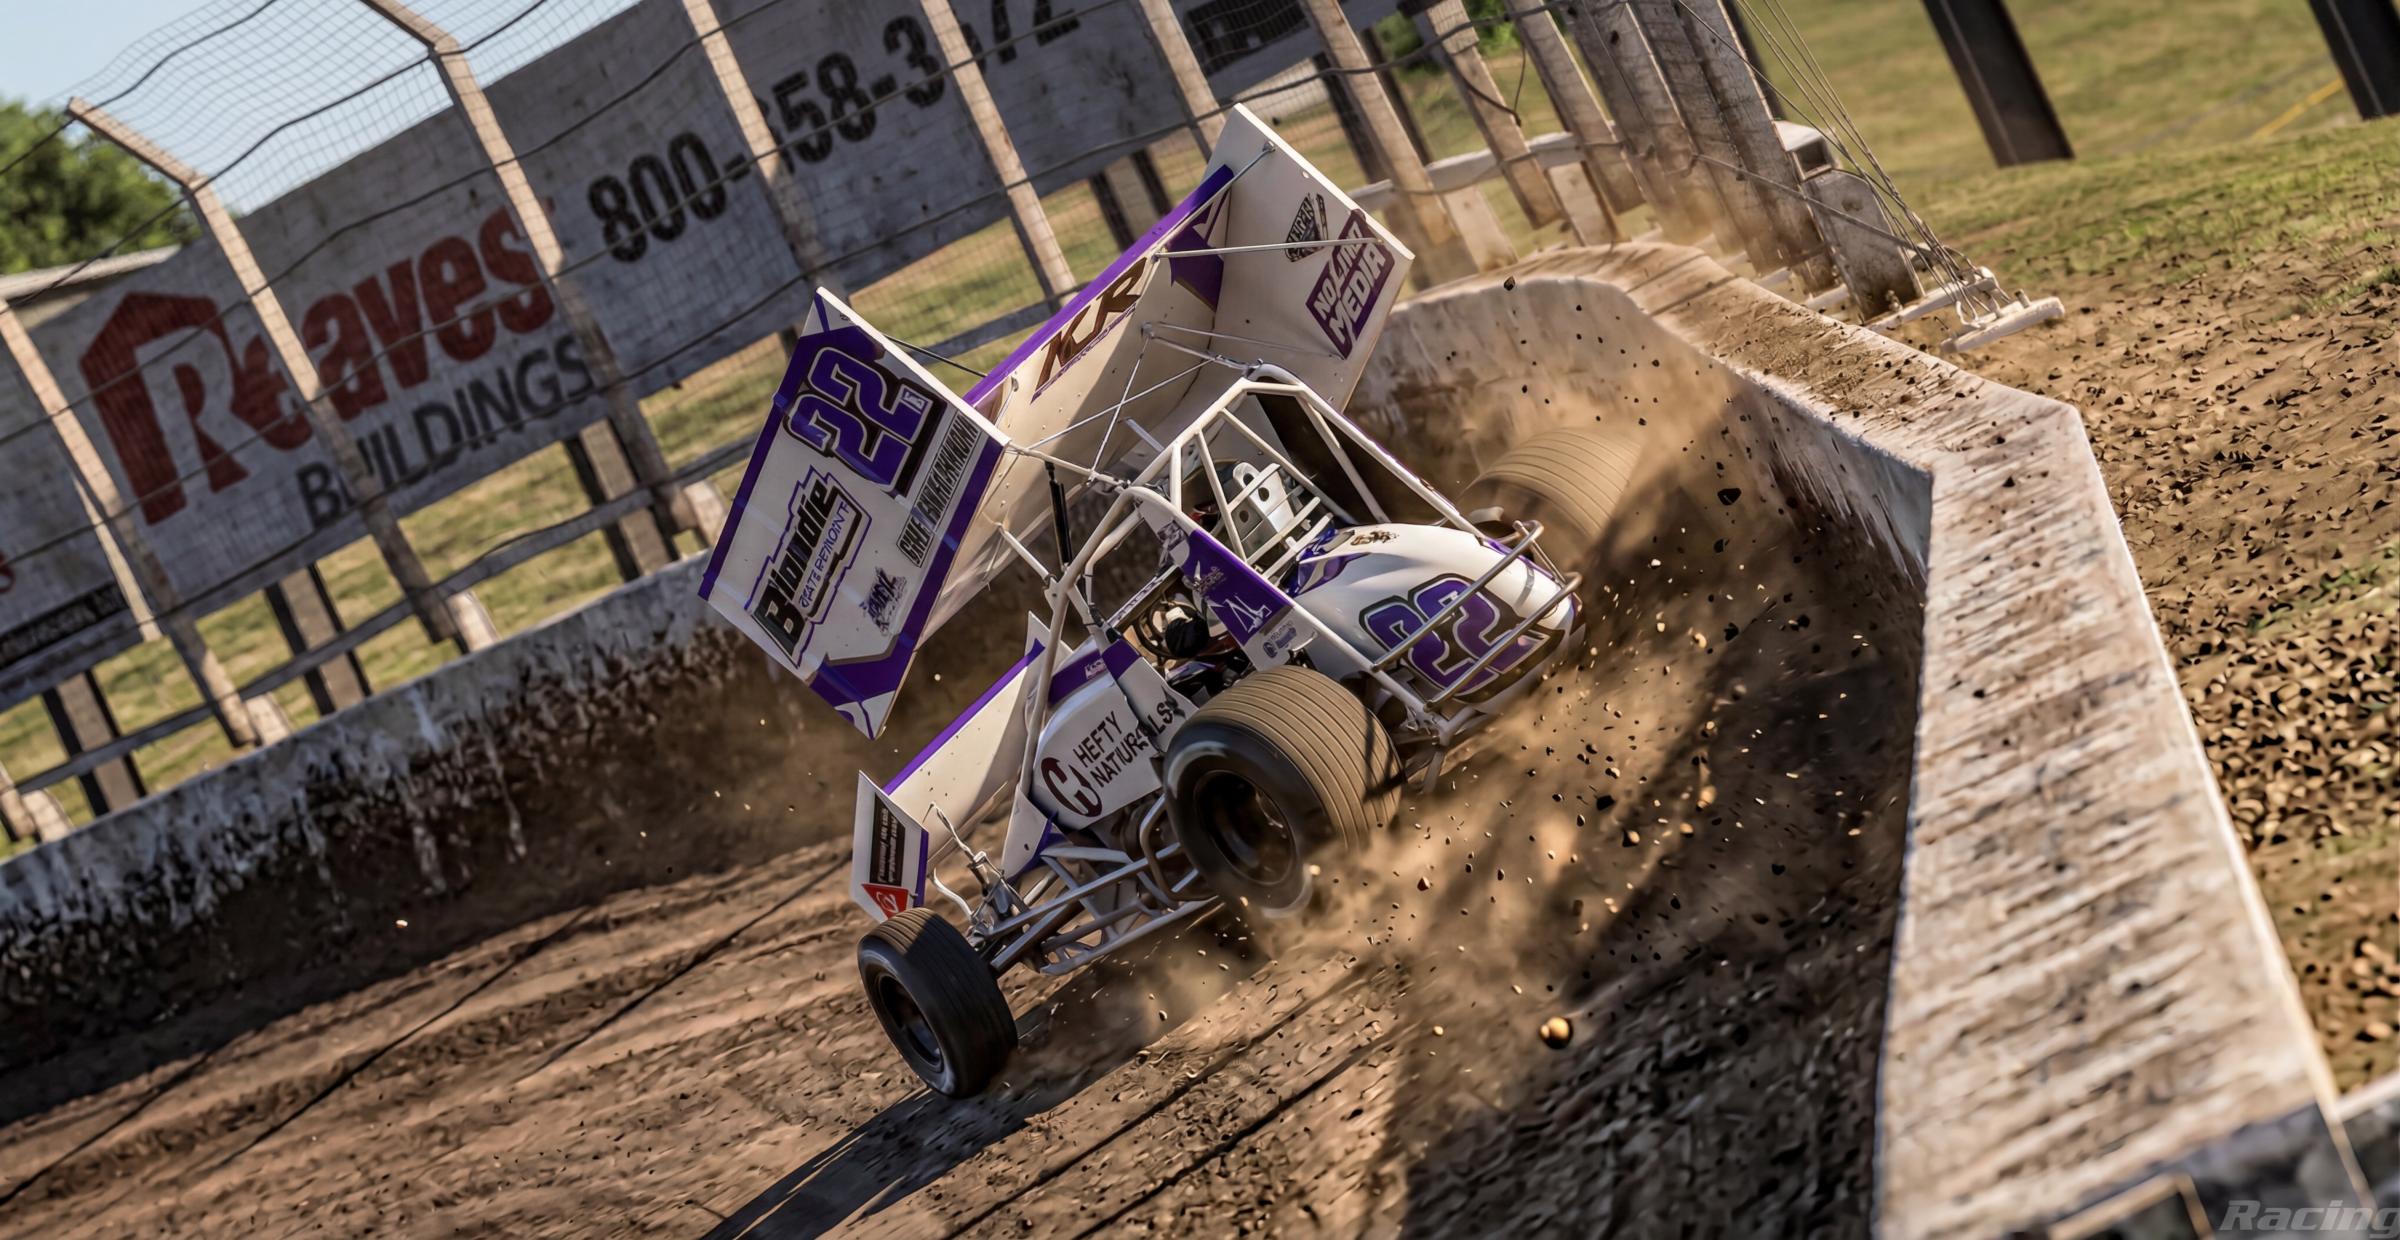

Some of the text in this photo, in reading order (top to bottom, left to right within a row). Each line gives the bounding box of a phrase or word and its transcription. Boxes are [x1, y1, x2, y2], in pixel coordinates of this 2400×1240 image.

[1328, 243, 1387, 346] MEDIA
[788, 346, 933, 489] 22
[752, 478, 841, 657] Blondie
[1363, 576, 1551, 696] 22
[1073, 711, 1123, 768] HEFTY
